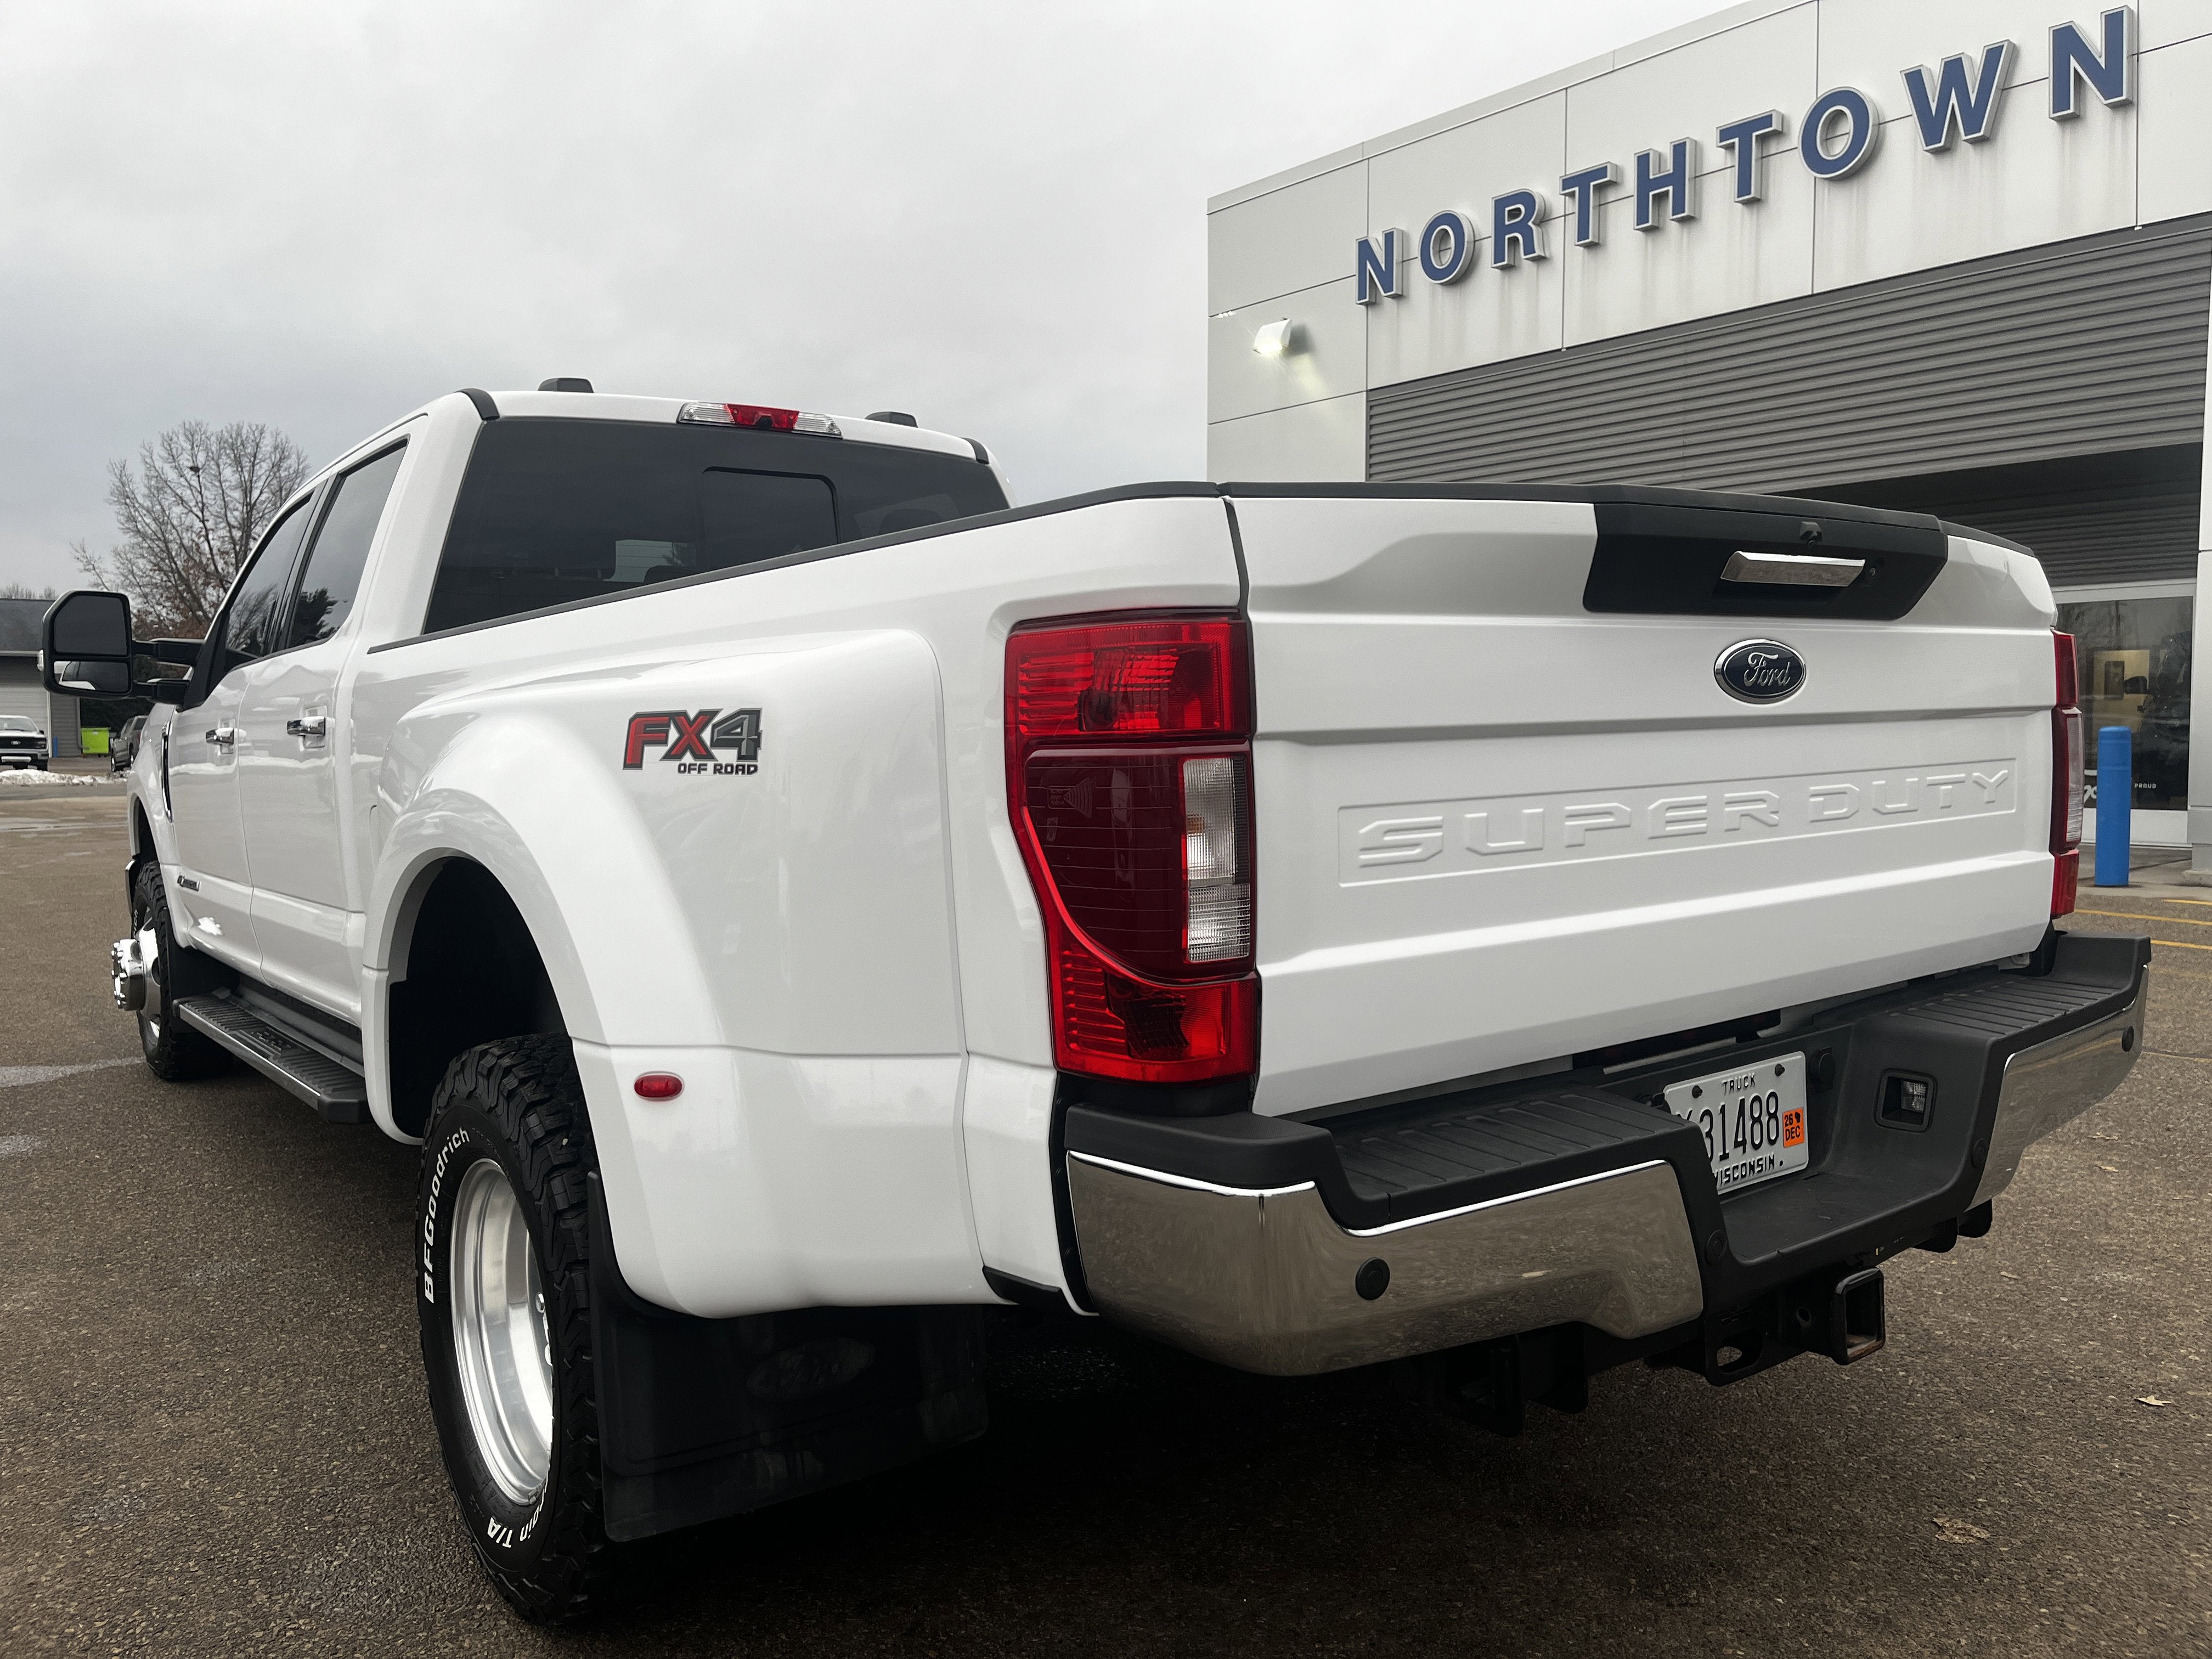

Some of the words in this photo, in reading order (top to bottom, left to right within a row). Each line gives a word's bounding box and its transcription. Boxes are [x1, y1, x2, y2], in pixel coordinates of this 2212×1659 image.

[1356, 5, 2134, 306] NORTHTOWN
[1743, 652, 1791, 687] Ford
[623, 708, 762, 771] FX4
[678, 762, 708, 775] OFF
[713, 763, 758, 776] ROAD
[1359, 790, 1779, 867] SUPER
[1809, 769, 2008, 823] DUTY
[1723, 1074, 1756, 1094] TRUCK
[1676, 1091, 1779, 1163] 31488
[1784, 1114, 1793, 1127] 26
[1785, 1125, 1801, 1142] DEC
[424, 1126, 470, 1304] BFGoodrich
[487, 1516, 514, 1549] T/A
